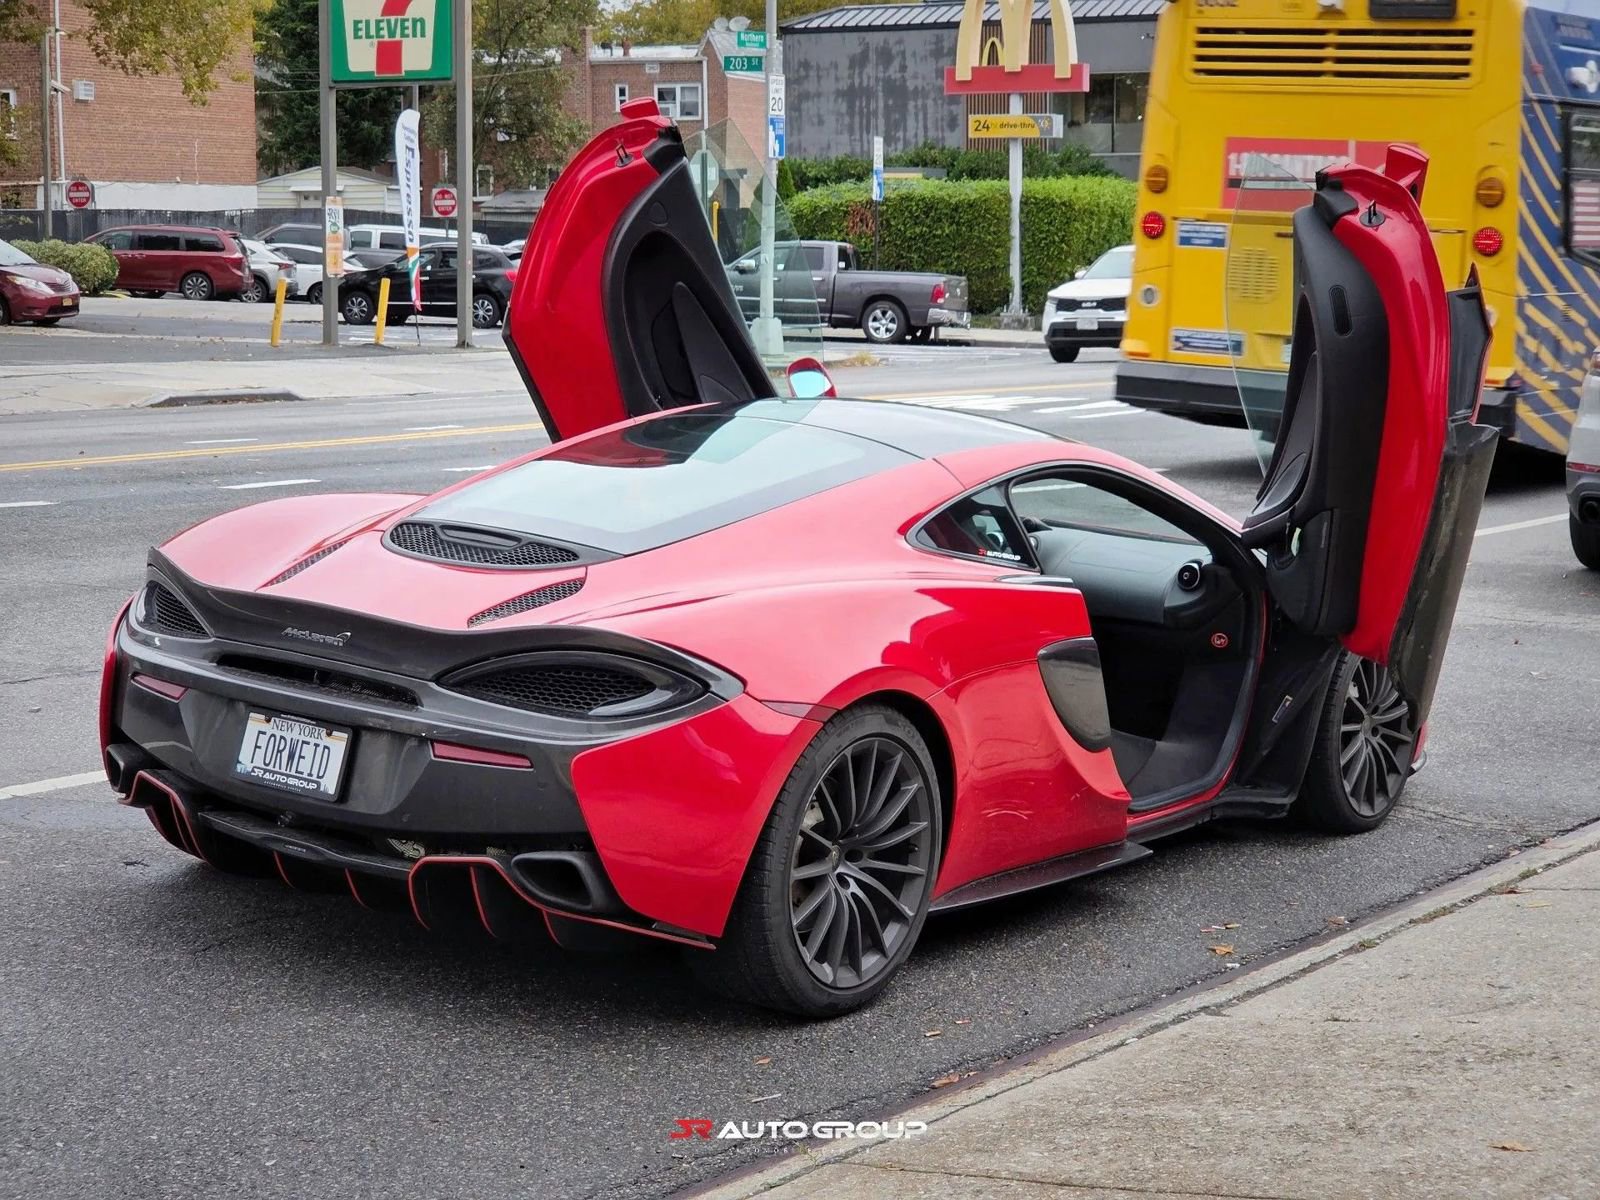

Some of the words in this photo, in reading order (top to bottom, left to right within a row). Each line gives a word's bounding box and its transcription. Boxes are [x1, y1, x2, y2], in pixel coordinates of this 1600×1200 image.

[730, 57, 747, 70] 203
[771, 97, 783, 111] 20
[974, 119, 990, 132] 24
[404, 144, 415, 242] Espresso
[271, 718, 296, 734] NEW
[298, 724, 326, 740] YORK
[250, 730, 331, 780] FORWEID
